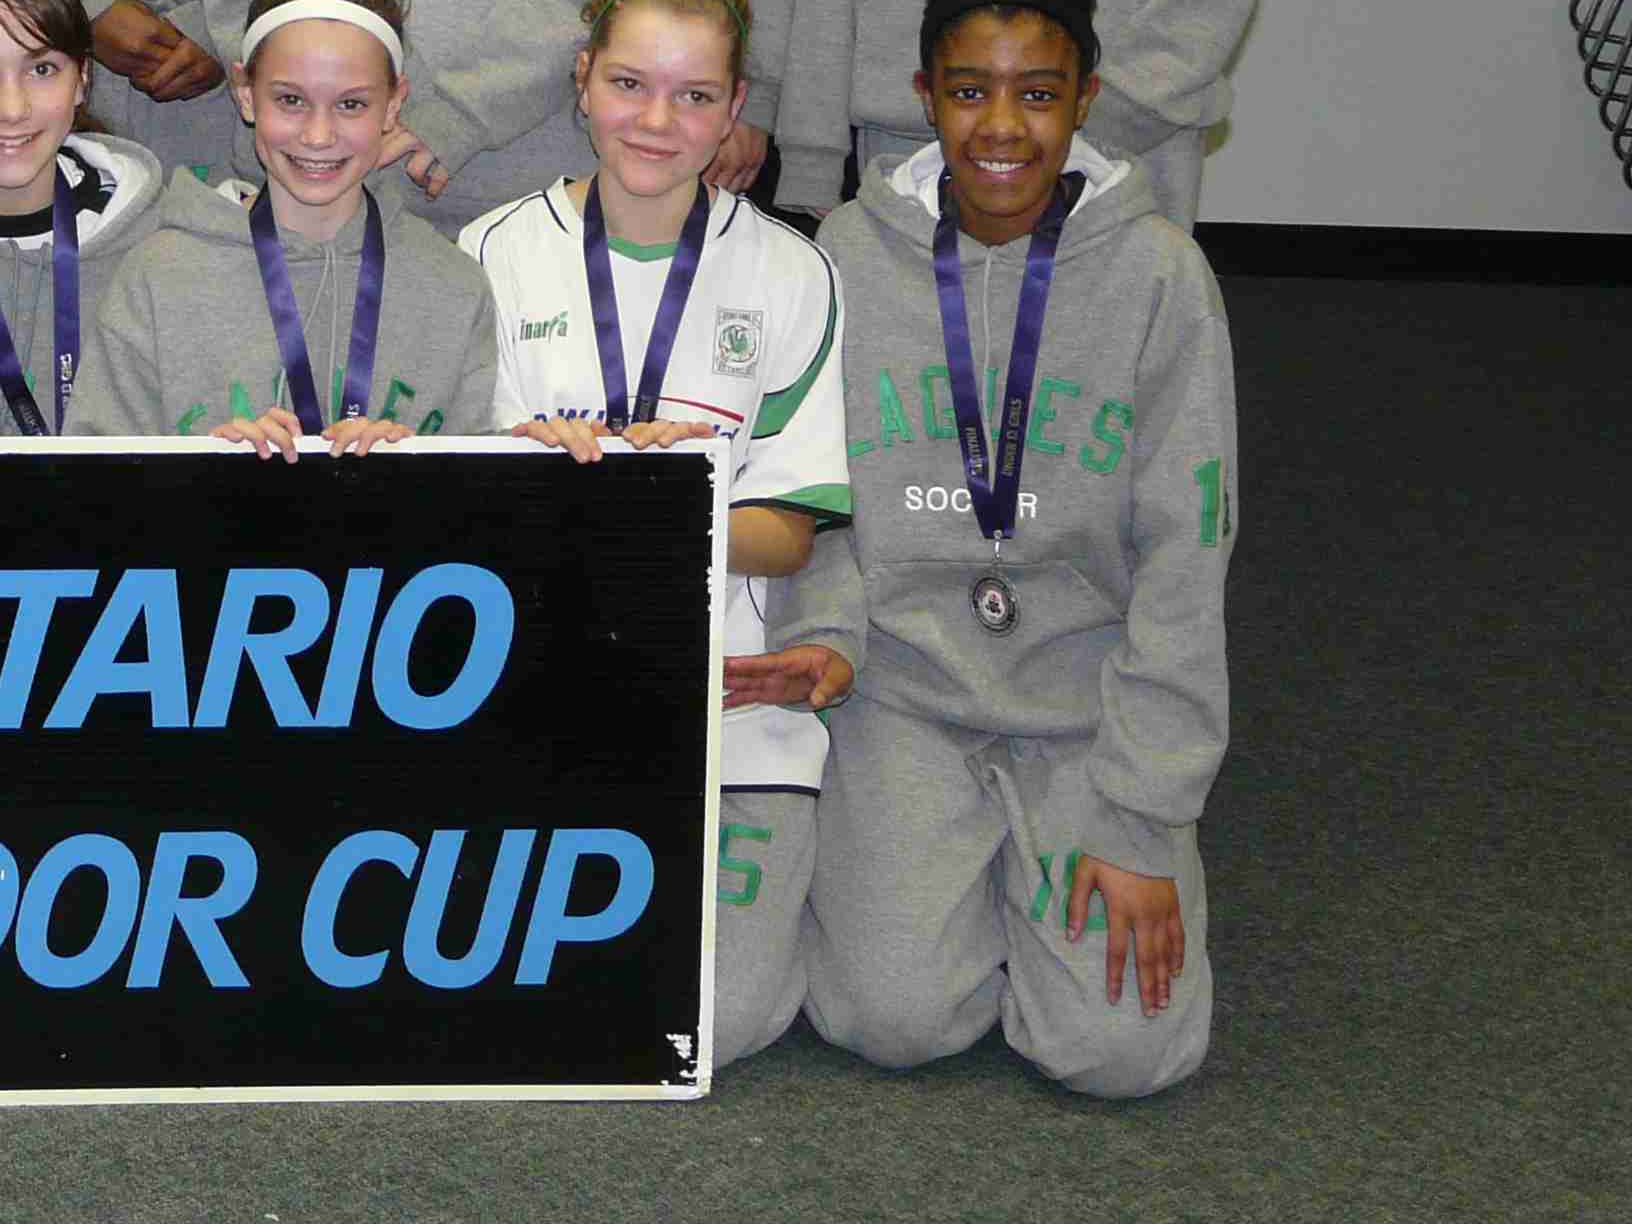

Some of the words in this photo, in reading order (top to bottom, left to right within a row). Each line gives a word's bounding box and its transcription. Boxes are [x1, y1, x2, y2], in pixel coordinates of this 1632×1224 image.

[904, 485, 1039, 520] SOCR
[717, 822, 772, 906] 5
[301, 828, 654, 989] CUP
